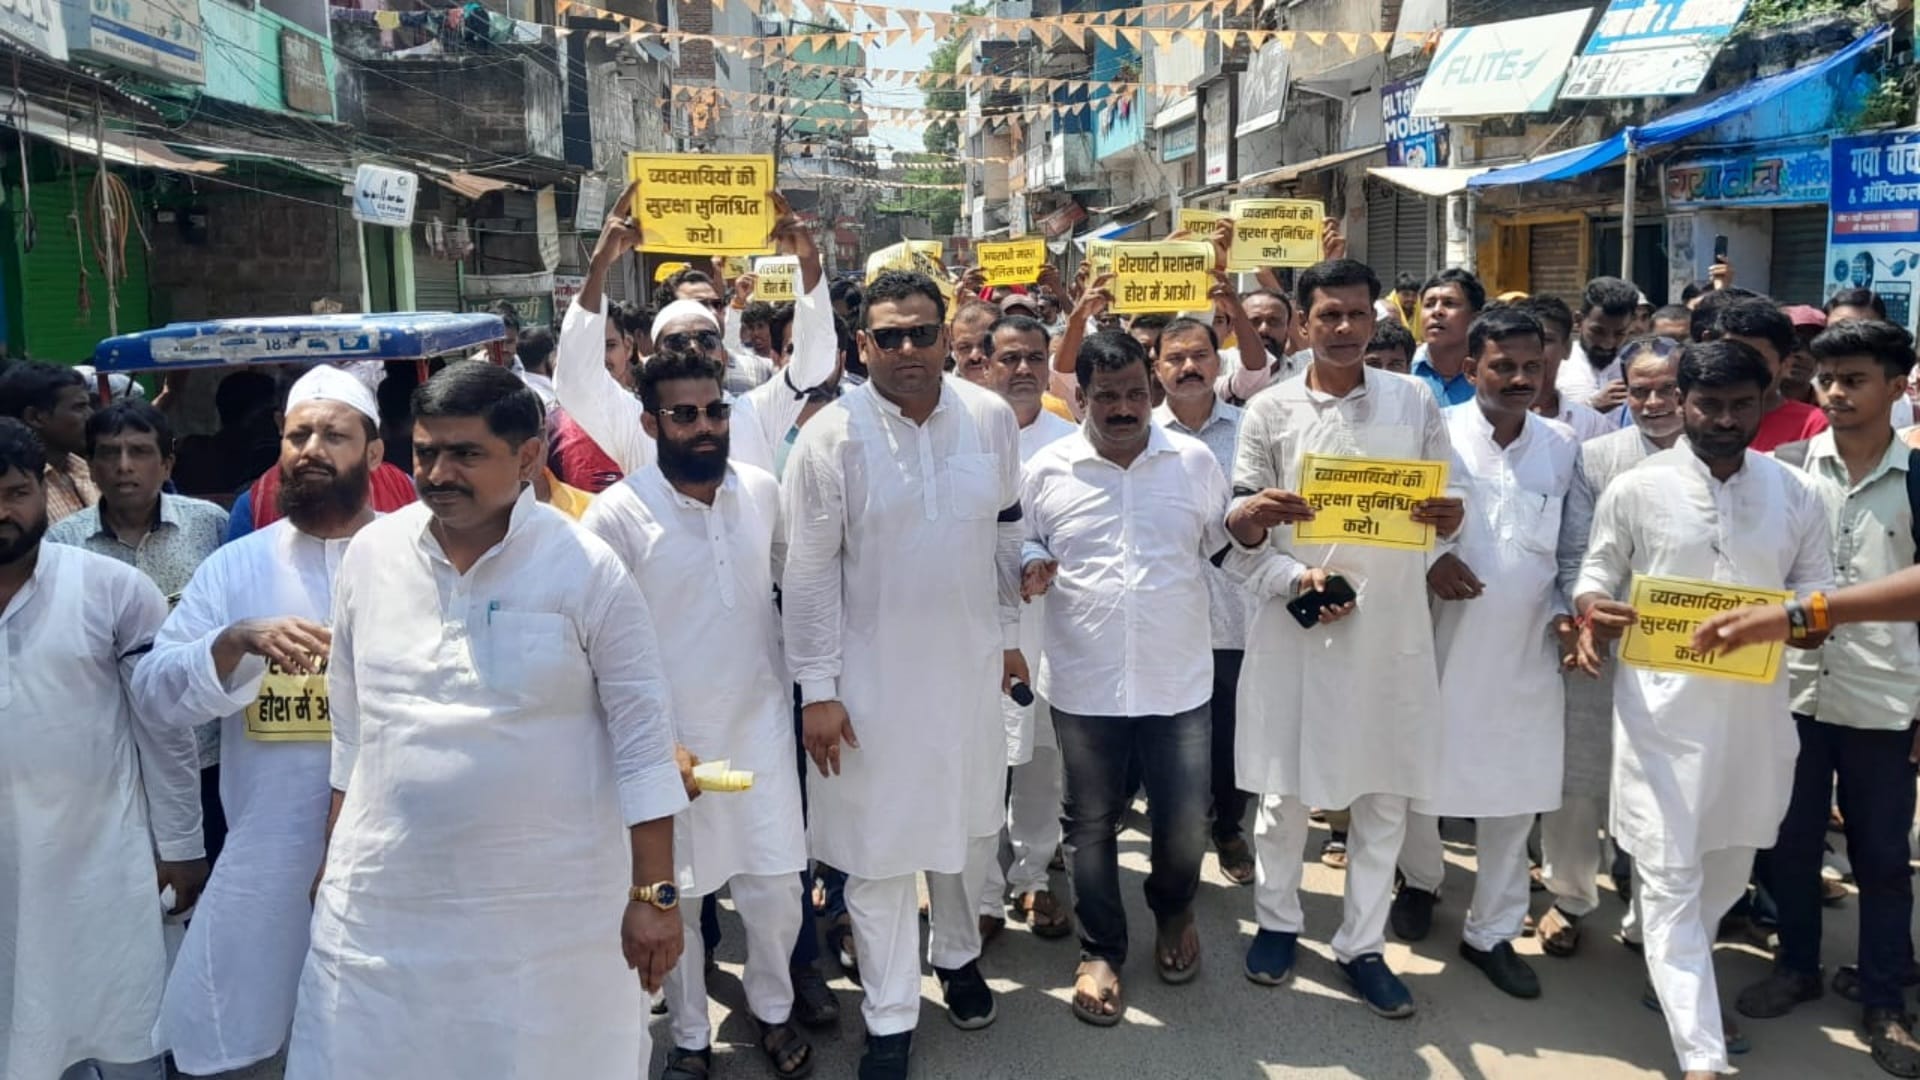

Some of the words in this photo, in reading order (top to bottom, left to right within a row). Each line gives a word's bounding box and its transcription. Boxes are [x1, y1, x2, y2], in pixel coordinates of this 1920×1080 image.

[1441, 47, 1524, 87] FLITE
[648, 165, 734, 186] व्यवसायियों
[736, 165, 757, 186] की
[645, 198, 692, 219] सुरक्षा
[695, 195, 760, 220] सुनिश्चित
[1242, 205, 1298, 220] व्यवसायियों
[1299, 206, 1313, 220] की
[1238, 228, 1267, 242] सुरक्षा
[1270, 226, 1315, 242] सुनिश्चित
[1118, 252, 1159, 274] शेरघाटी
[1162, 254, 1205, 275] प्रशासन
[1125, 280, 1147, 302] होश
[1150, 280, 1163, 301] में
[1315, 467, 1398, 486] व्यवसायियों
[1402, 470, 1424, 488] की
[1309, 493, 1352, 511] सुरक्षा
[1640, 615, 1692, 635] सुरक्षा
[259, 687, 291, 722] होश
[293, 687, 314, 722] में
